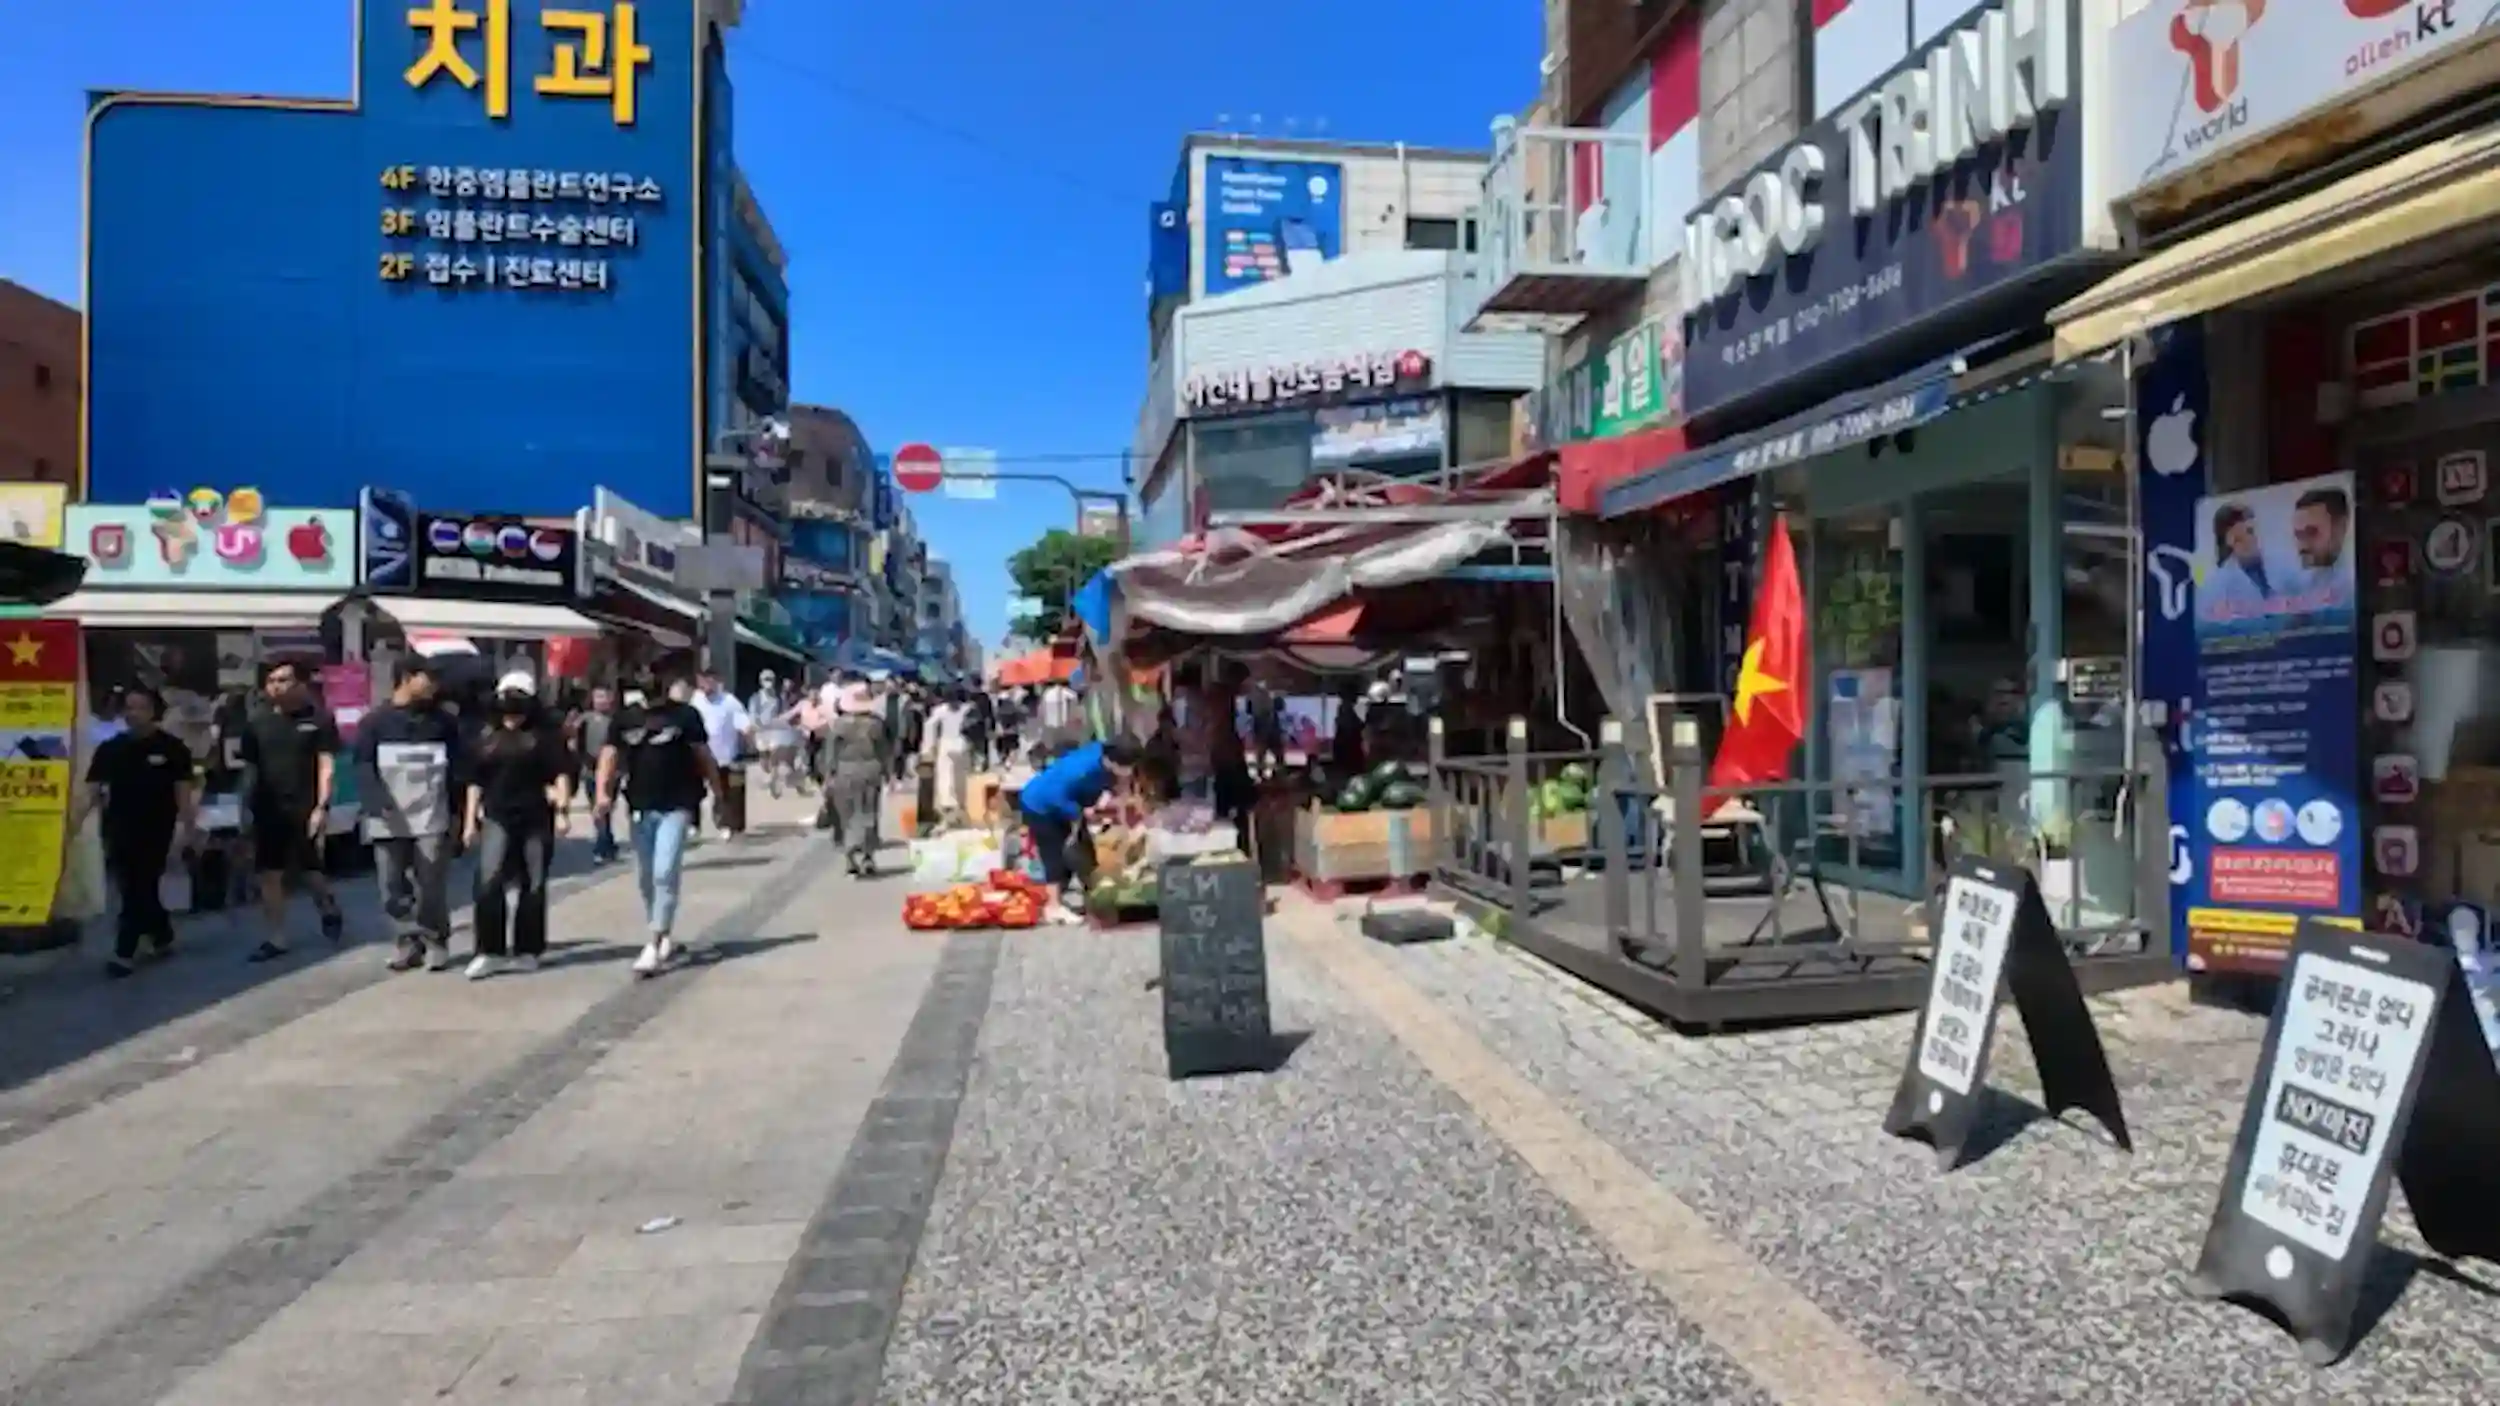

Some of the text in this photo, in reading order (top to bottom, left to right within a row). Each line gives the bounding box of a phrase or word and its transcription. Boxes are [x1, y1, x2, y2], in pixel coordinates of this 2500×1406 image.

[404, 0, 651, 123] 치과
[2345, 2, 2454, 76] olleh kt
[1837, 0, 2069, 218] TRINH
[2184, 97, 2249, 149] world
[380, 166, 416, 191] 4F
[380, 208, 415, 236] 3F
[380, 252, 415, 280] 2F
[2314, 1018, 2381, 1061] 그러나
[2278, 1141, 2343, 1195] 휴대폰
